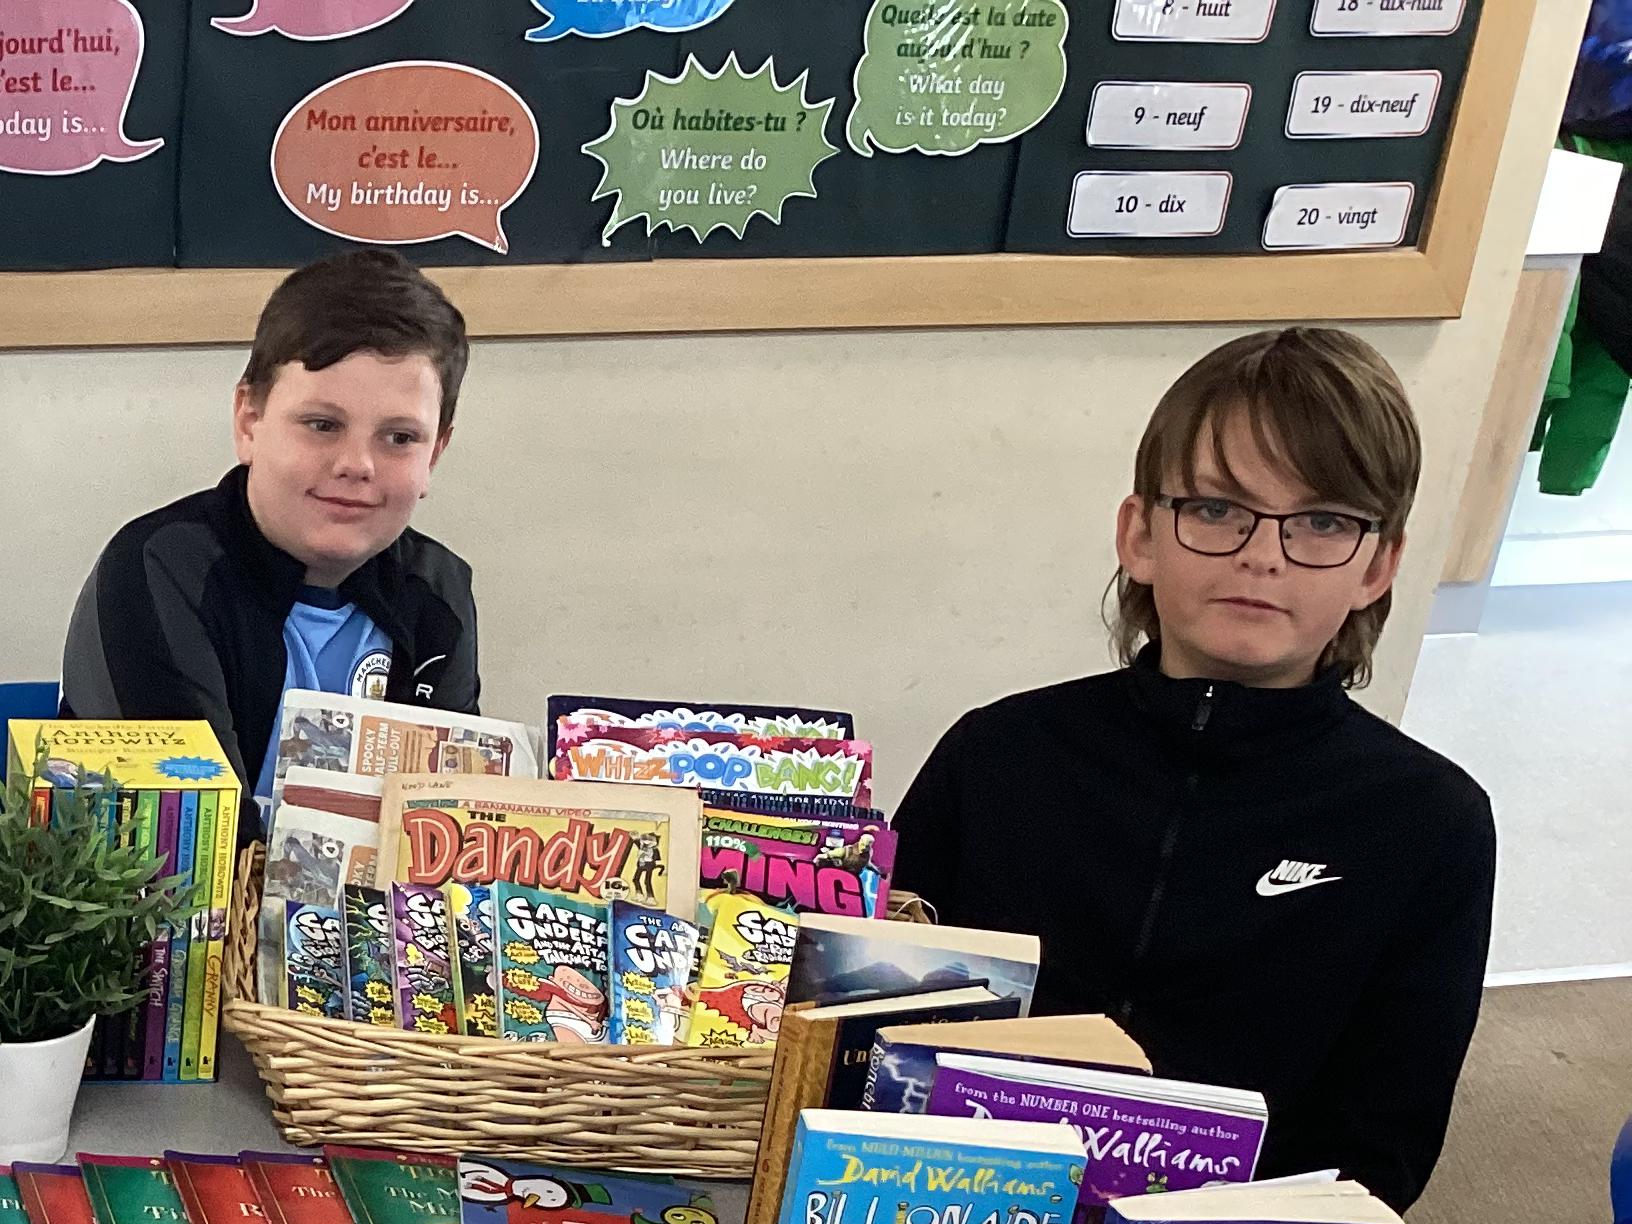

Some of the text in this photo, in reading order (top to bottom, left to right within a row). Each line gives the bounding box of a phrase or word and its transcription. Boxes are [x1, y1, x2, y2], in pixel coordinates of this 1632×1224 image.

[52, 70, 97, 92] le...
[1311, 94, 1419, 117] 19 dix-neuf
[62, 111, 106, 135] is...
[306, 109, 515, 136] Mon anniversaire,
[632, 108, 786, 131] Où habites-tu
[1133, 107, 1208, 130] 9 neuf
[359, 145, 458, 168] c'est le...
[661, 148, 767, 170] Where do
[306, 182, 499, 210] My birthday is...
[659, 185, 756, 210] you live?
[1115, 195, 1186, 213] 10 dix
[1297, 206, 1377, 228] 20 vingt
[405, 809, 640, 896] Dandy
[1270, 859, 1327, 882] NIKE
[204, 954, 223, 1018] GRANNY
